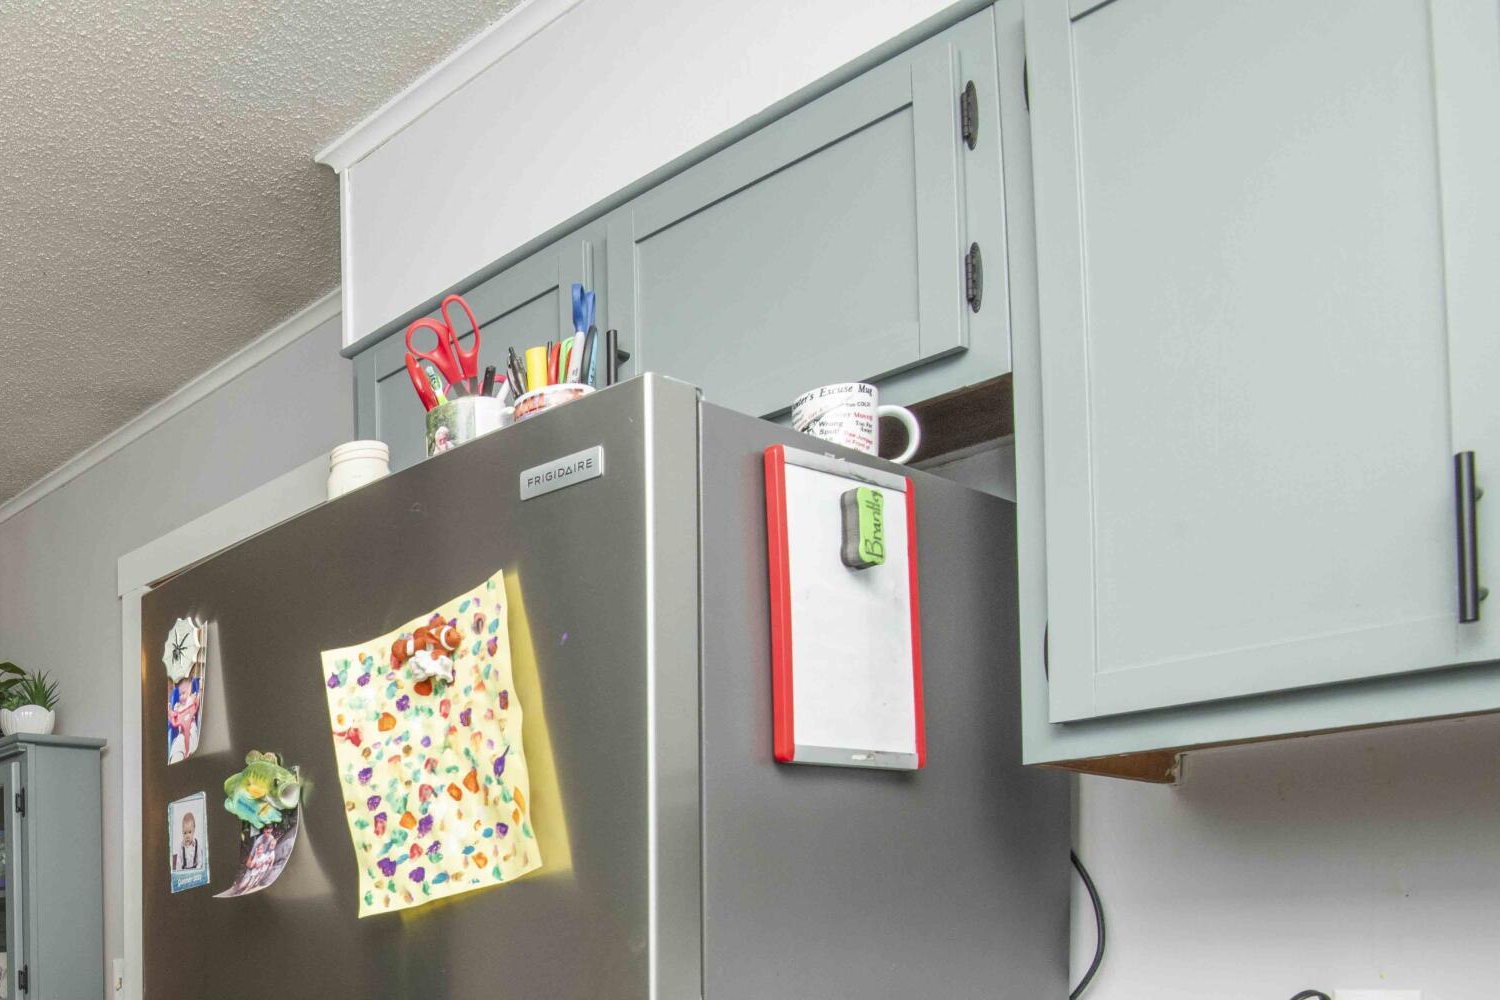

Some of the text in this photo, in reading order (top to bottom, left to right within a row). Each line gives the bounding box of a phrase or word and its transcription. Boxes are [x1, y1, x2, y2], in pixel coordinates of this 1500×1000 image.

[819, 386, 853, 398] Excuse
[858, 384, 873, 397] Mug
[527, 458, 593, 489] FRIGIDAIRE
